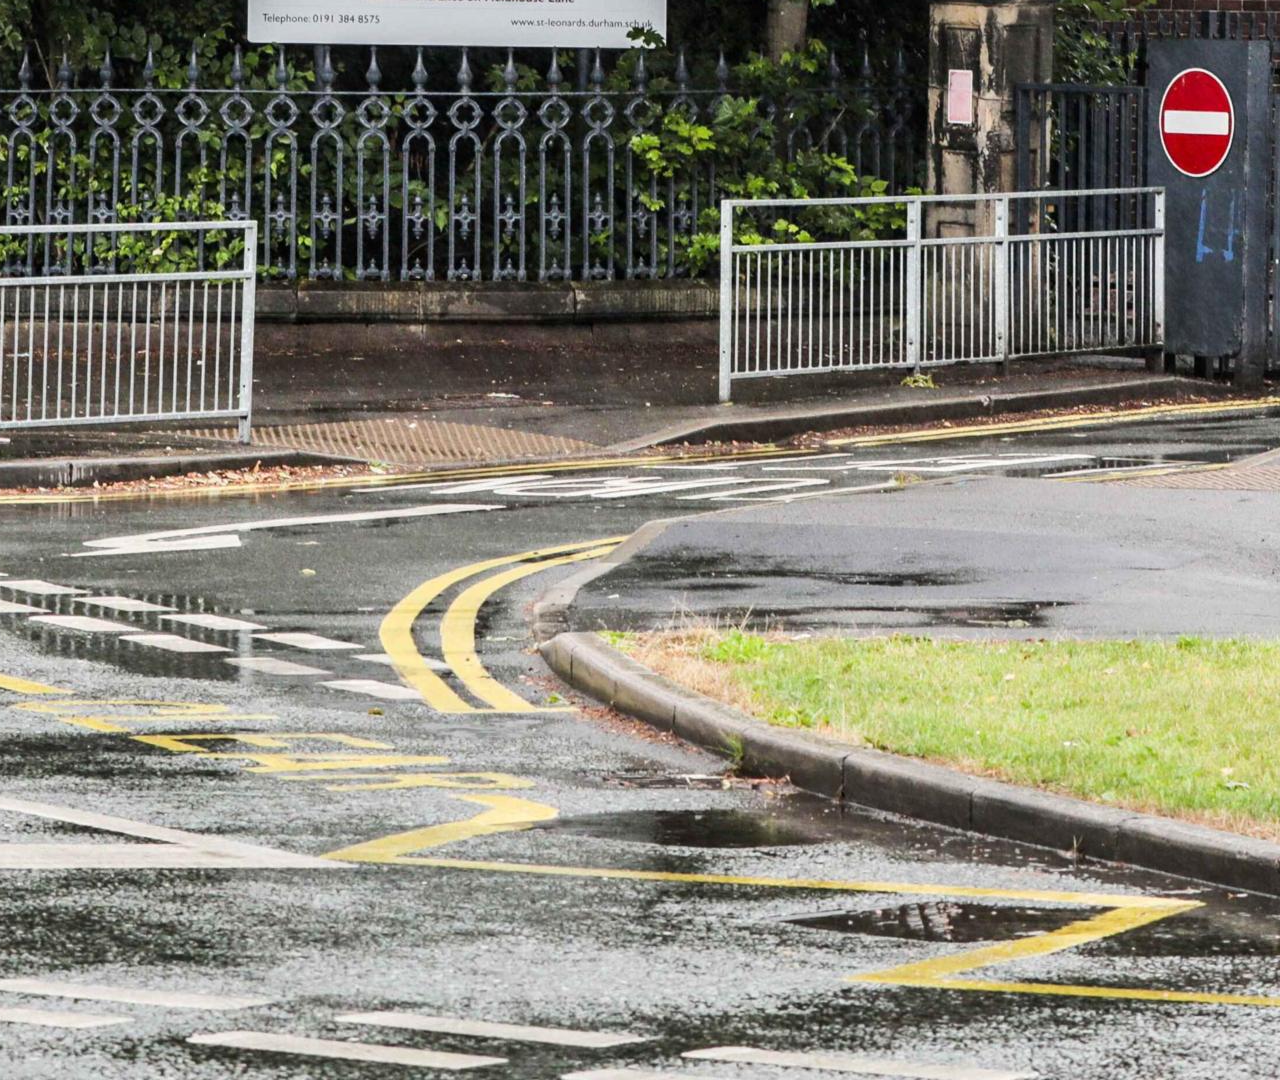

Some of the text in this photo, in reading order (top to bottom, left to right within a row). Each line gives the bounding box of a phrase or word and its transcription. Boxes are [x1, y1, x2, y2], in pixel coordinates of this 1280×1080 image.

[262, 12, 381, 26] Telephone: 0191 384 8575
[510, 17, 654, 29] www.st-leonards.durham.sch.uk
[9, 700, 537, 792] CLEAR
